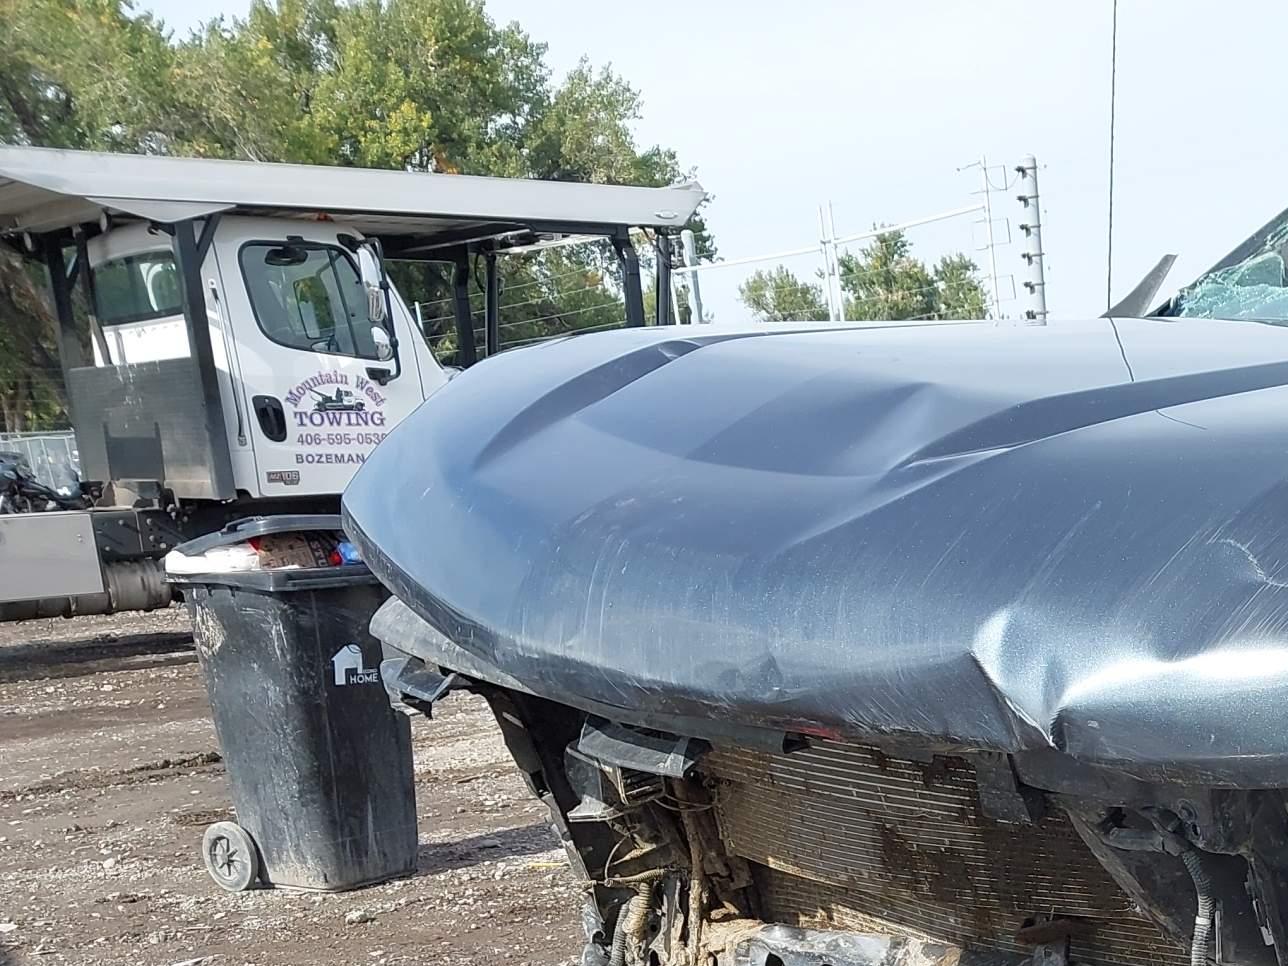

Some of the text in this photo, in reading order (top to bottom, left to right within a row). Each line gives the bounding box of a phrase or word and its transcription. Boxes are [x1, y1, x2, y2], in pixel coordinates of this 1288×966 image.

[285, 370, 387, 407] Mountain West
[294, 411, 386, 427] TOWING
[296, 453, 365, 464] BOZEMAN
[350, 673, 379, 684] HOME
